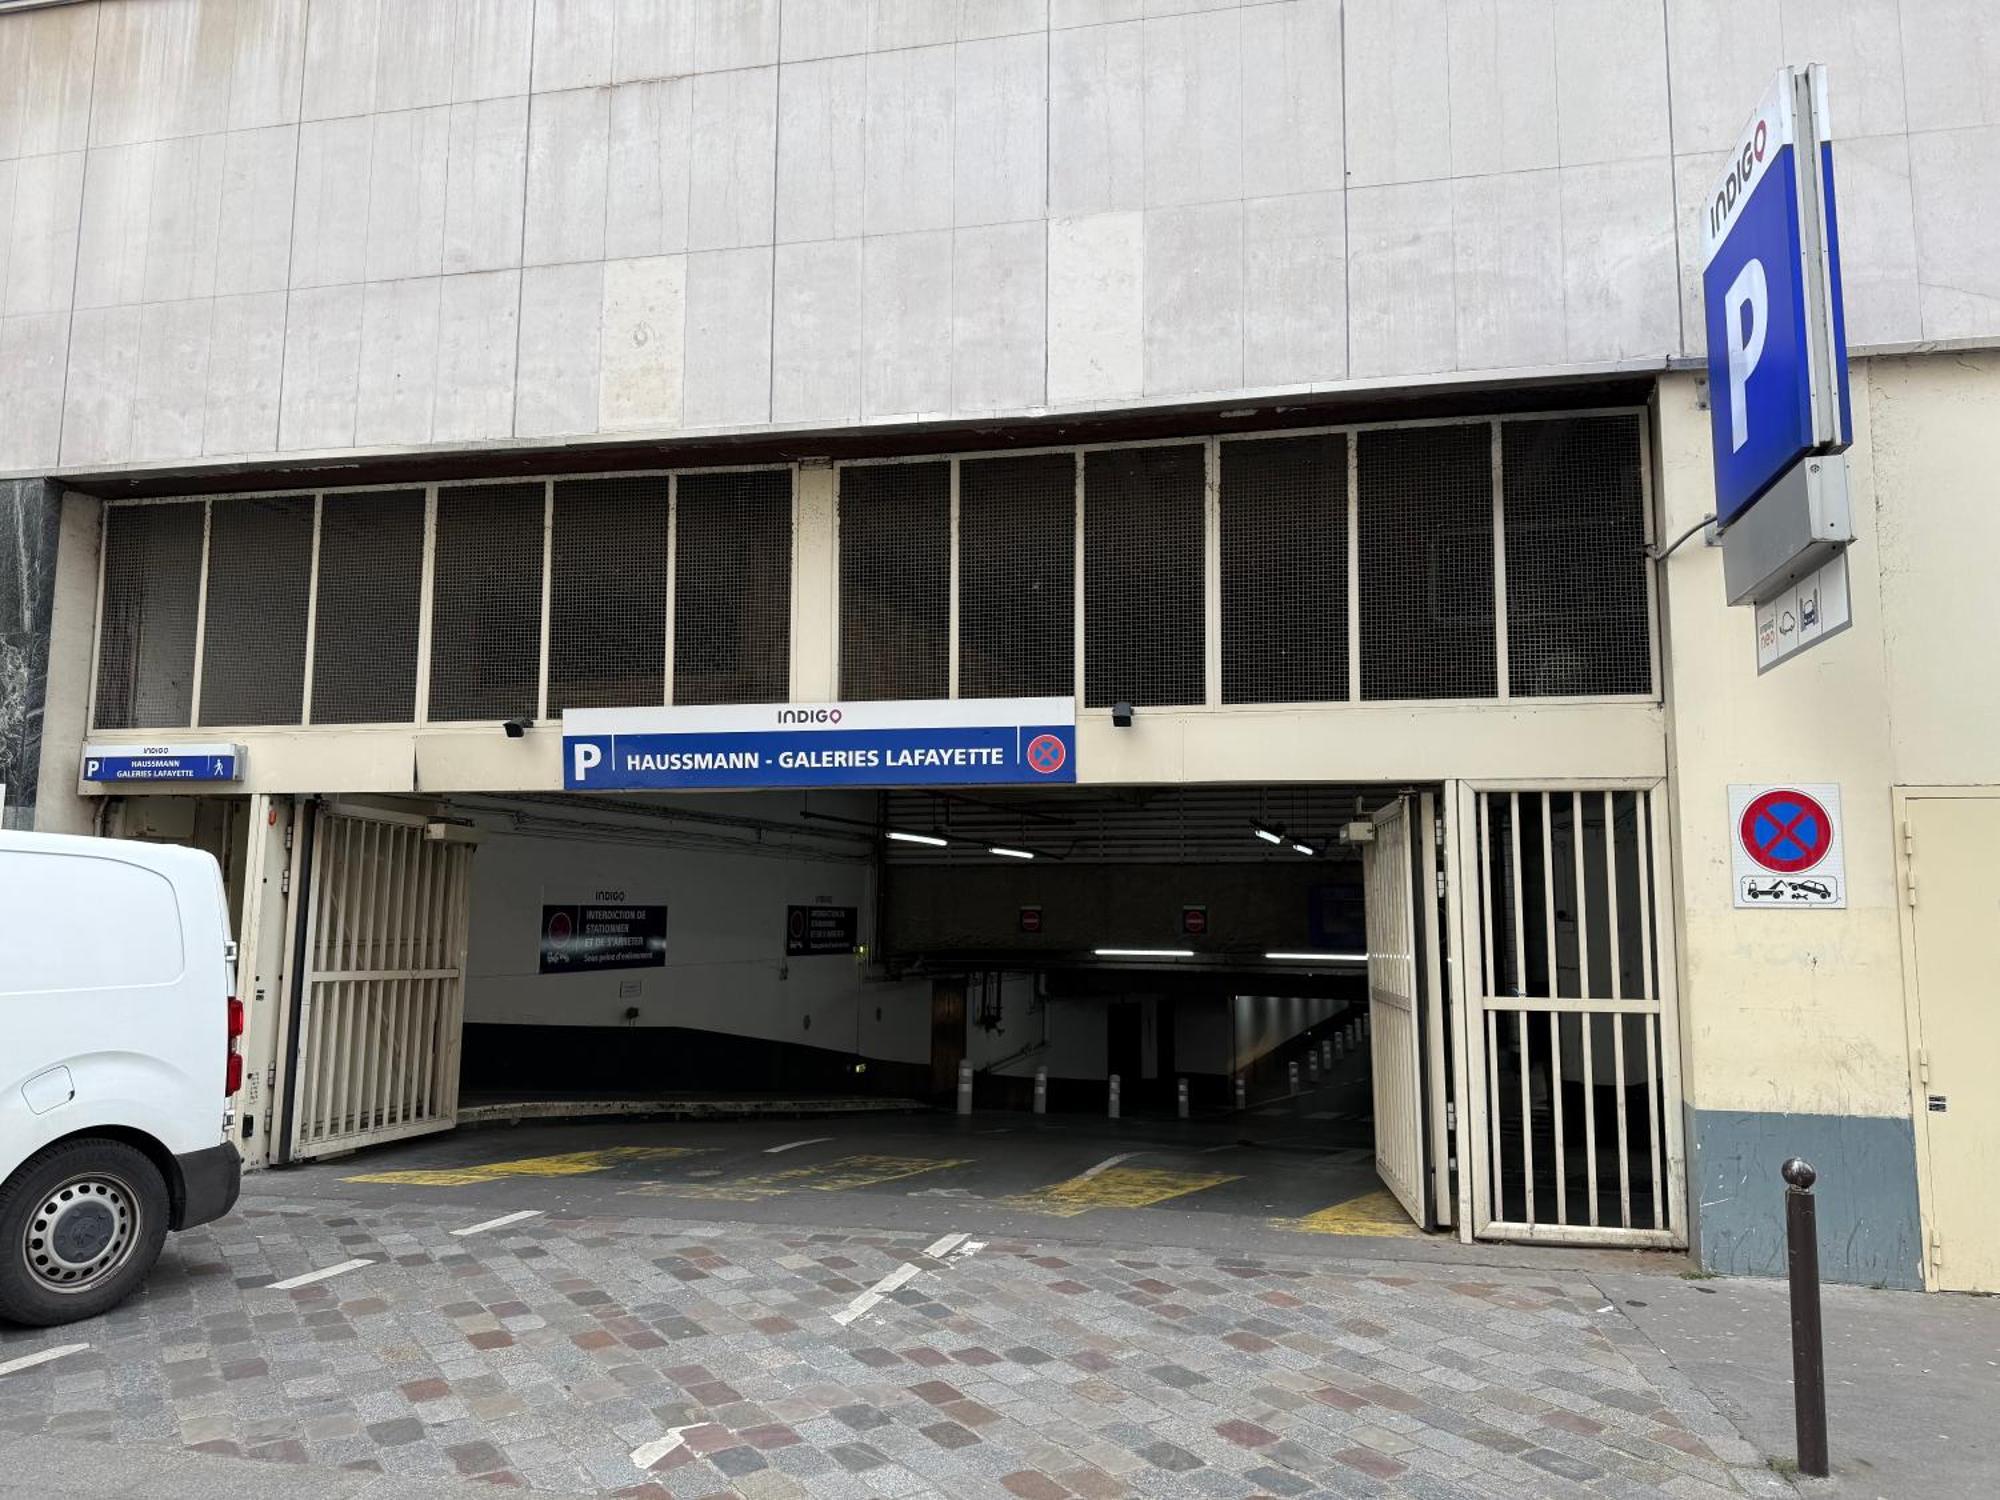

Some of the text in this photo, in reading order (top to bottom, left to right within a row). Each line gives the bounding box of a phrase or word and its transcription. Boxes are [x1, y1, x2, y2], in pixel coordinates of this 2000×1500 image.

[1710, 120, 1767, 239] INDIGO
[1725, 258, 1768, 453] P
[777, 708, 842, 724] INDIGO
[131, 760, 180, 768] HAUSSMANN
[573, 742, 602, 781] P
[626, 752, 759, 771] HAUSSMANN
[778, 750, 879, 768] GALERIES
[885, 748, 1004, 767] LAFAYETTE
[87, 760, 100, 777] P
[116, 770, 194, 778] GALERIES LAFAYETTE
[595, 891, 625, 902] INDIGO
[586, 910, 646, 920] INTERDICTION DE
[586, 923, 630, 933] STATIONNER
[584, 937, 593, 947] ET
